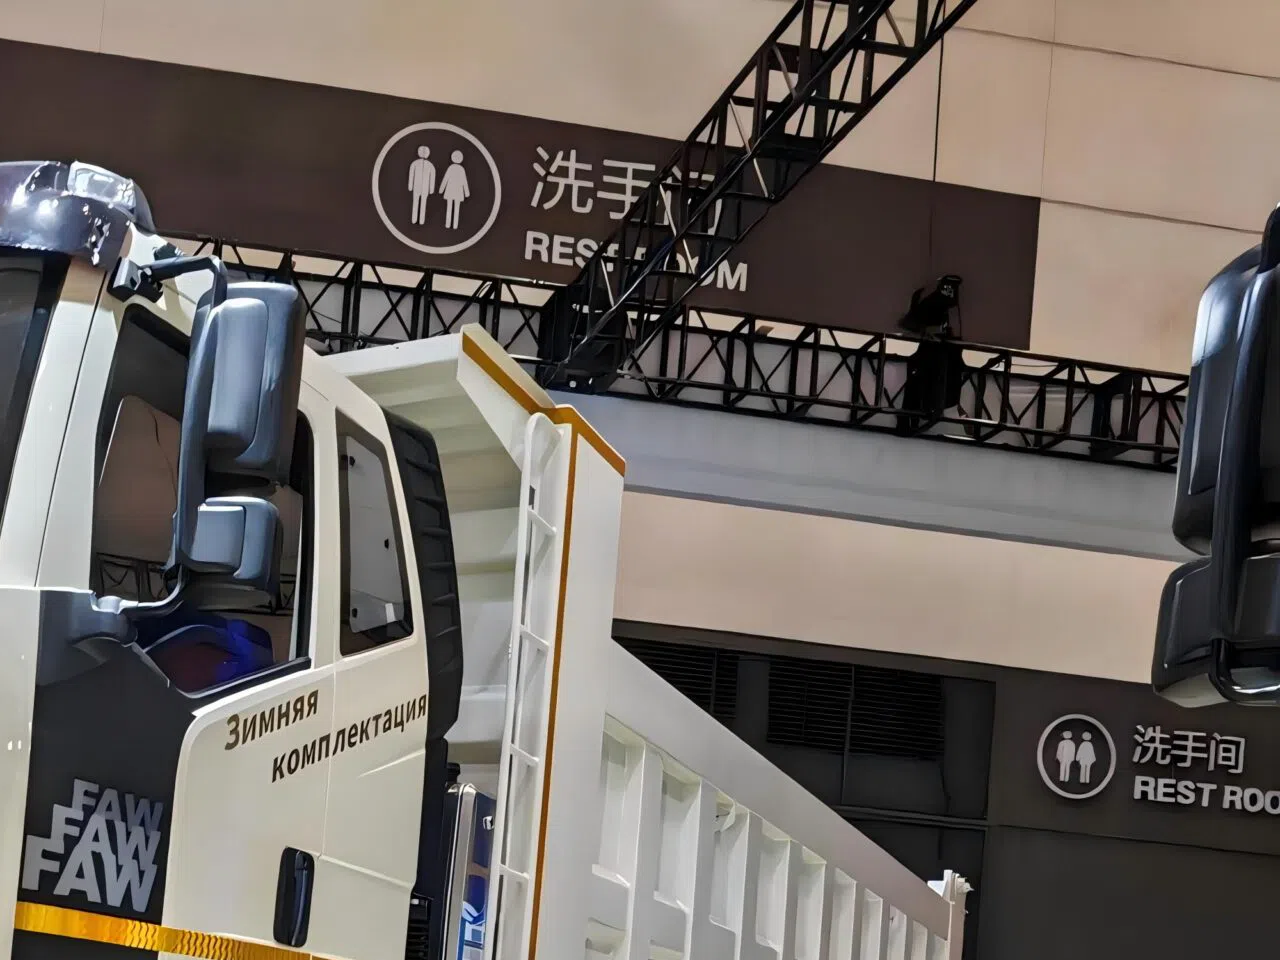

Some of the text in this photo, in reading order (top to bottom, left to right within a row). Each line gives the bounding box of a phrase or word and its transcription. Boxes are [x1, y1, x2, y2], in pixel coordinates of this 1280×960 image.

[224, 689, 319, 751] Зимняя
[272, 694, 427, 784] комплектация
[1132, 724, 1246, 774] 洗手间
[1133, 775, 1218, 807] REST
[21, 834, 158, 913] FAW
